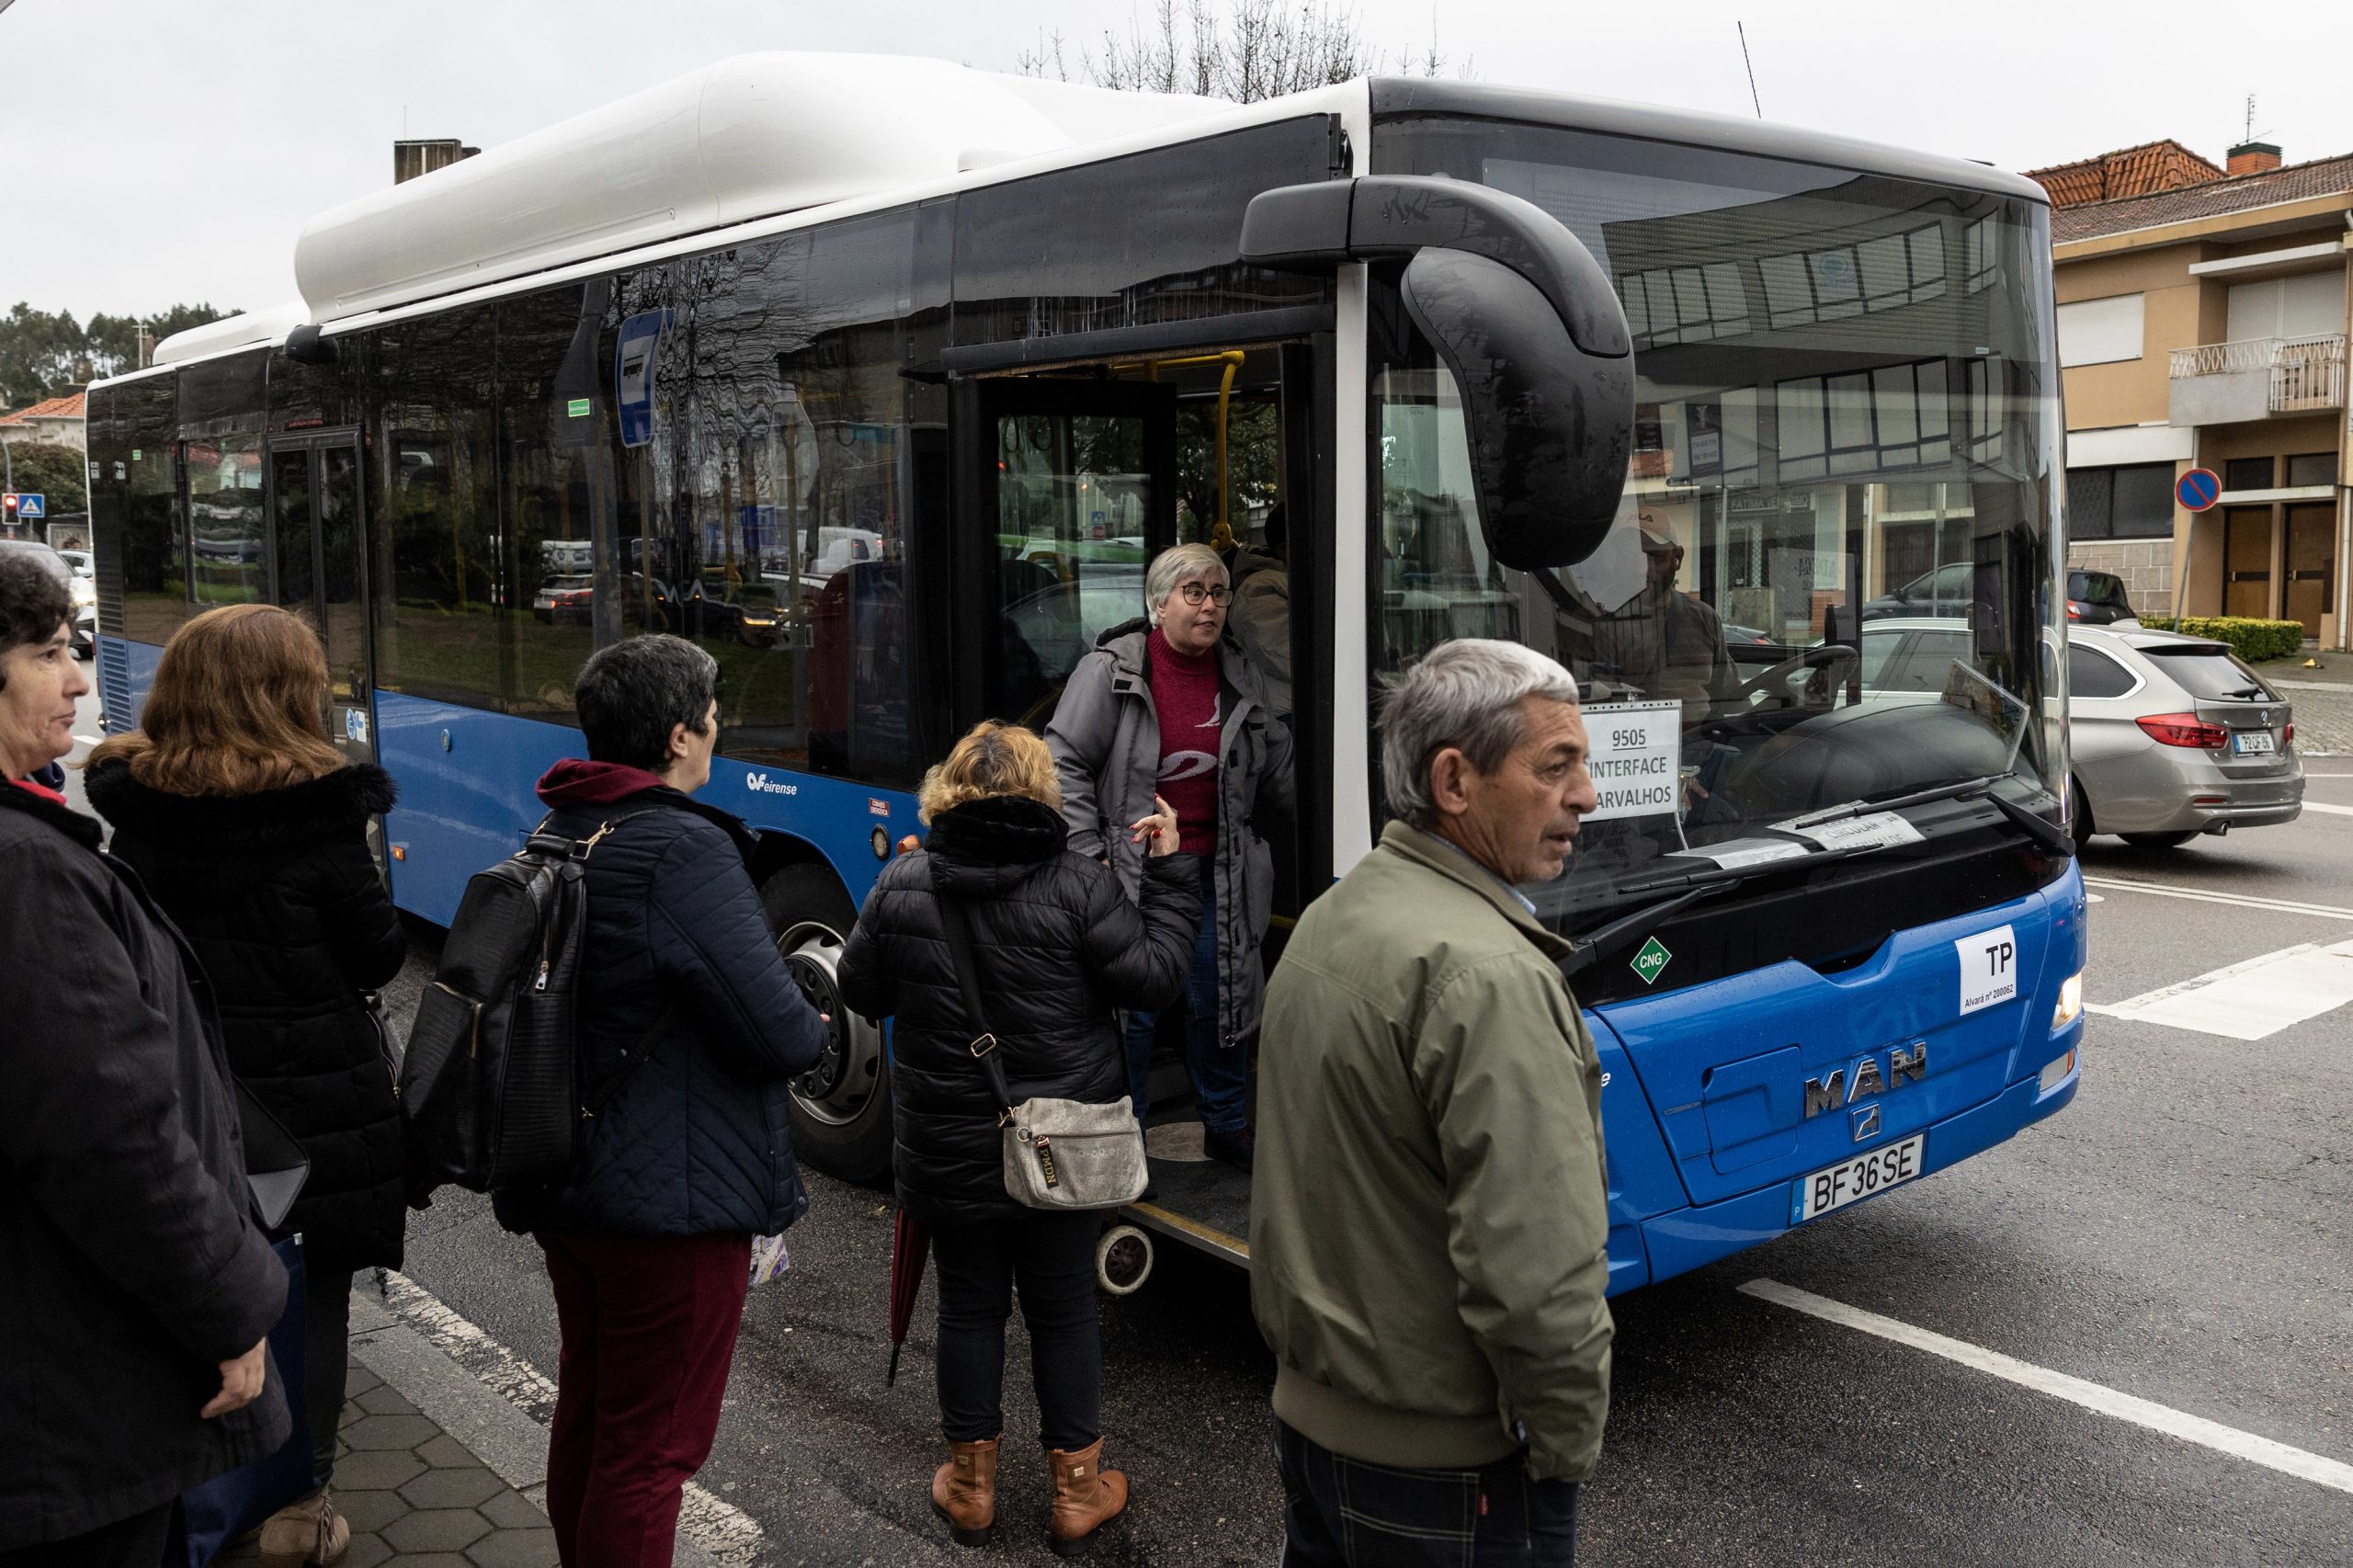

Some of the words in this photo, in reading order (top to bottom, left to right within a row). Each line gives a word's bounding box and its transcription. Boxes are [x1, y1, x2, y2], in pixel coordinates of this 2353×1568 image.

[1612, 728, 1646, 747] 9505
[1589, 756, 1667, 779] INTERFACE
[1597, 786, 1672, 809] ARVALHOS
[1824, 821, 1881, 839] CIRCULAR
[1639, 951, 1662, 969] CNG
[1985, 941, 2013, 977] TP
[1964, 994, 1984, 1008] Alvará
[1805, 1040, 1927, 1119] MAN
[1040, 1148, 1057, 1184] PMDN
[1794, 1207, 1802, 1217] P
